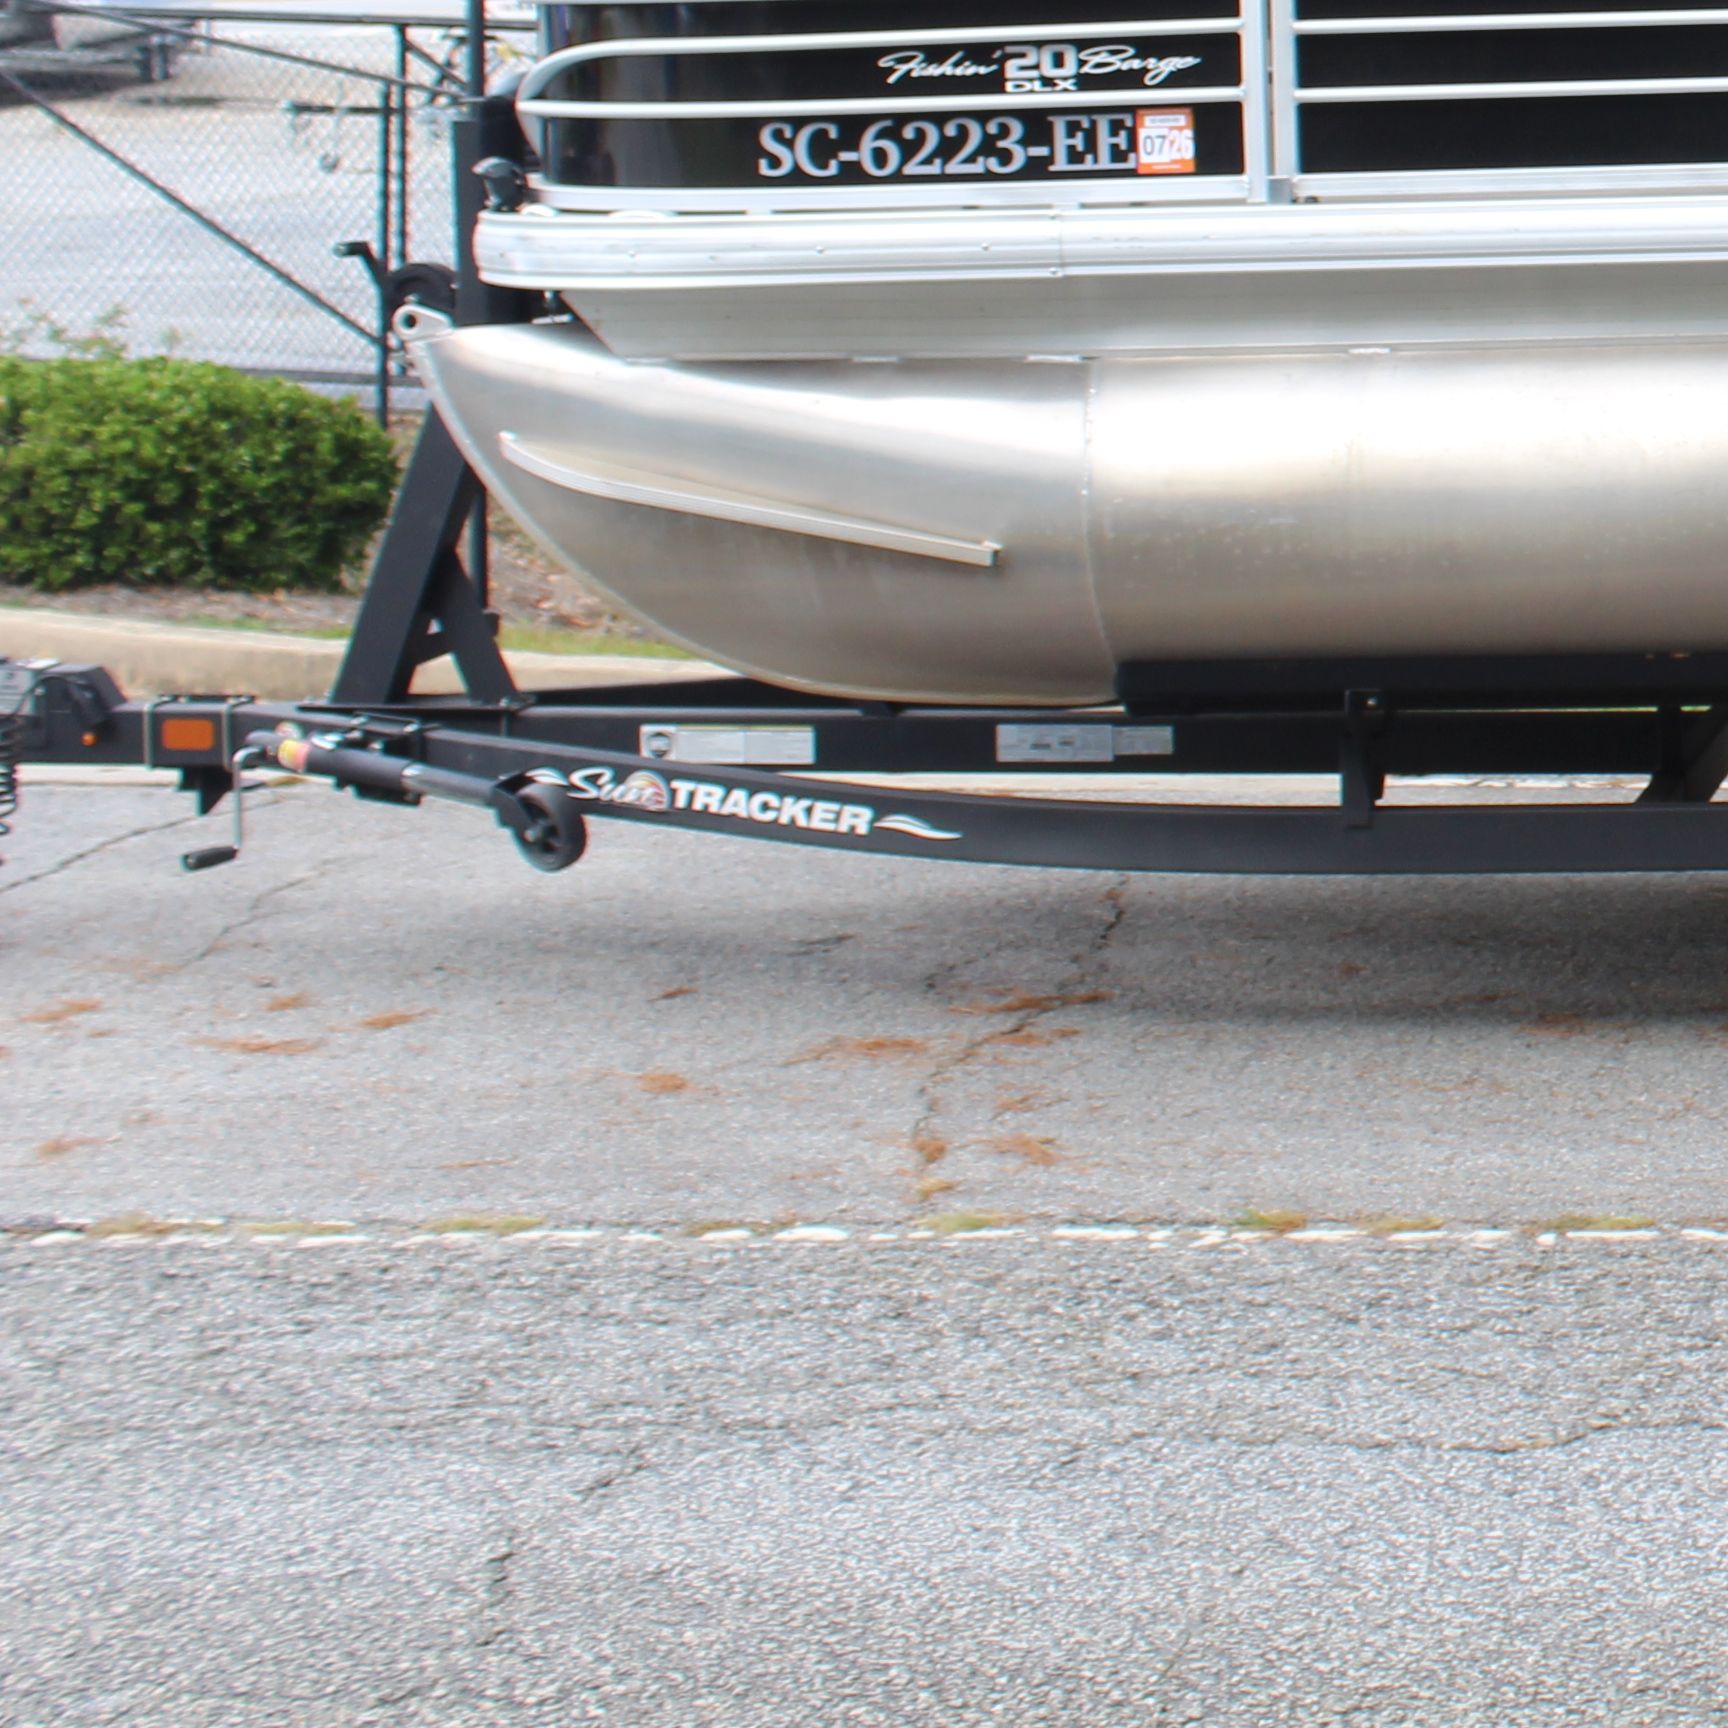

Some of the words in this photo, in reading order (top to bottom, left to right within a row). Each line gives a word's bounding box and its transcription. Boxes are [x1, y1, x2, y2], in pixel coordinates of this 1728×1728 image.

[1004, 44, 1077, 79] 20
[1078, 45, 1201, 85] Barge
[1004, 78, 1078, 93] DLX
[757, 113, 1137, 178] SC-6223-EE
[567, 767, 663, 810] Sun
[670, 779, 876, 836] TRACKER
